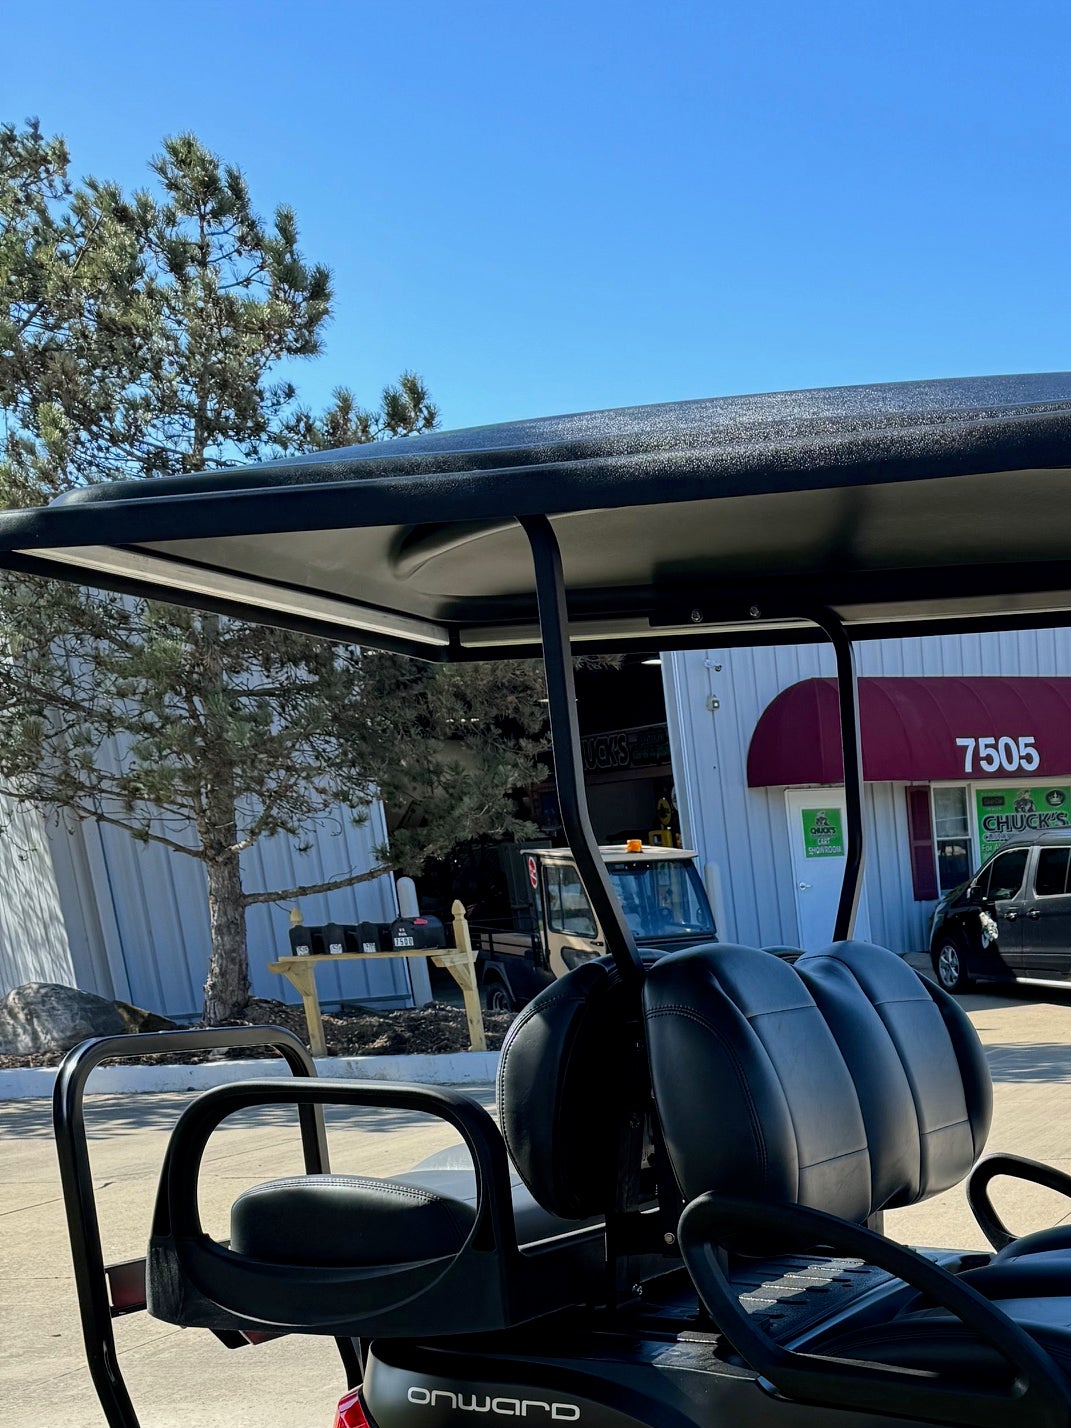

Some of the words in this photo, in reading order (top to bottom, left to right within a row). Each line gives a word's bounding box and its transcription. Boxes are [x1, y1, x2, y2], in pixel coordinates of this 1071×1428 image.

[580, 733, 631, 770] UCK'S
[955, 736, 1040, 773] 7505
[982, 812, 1069, 833] CHUCK'S
